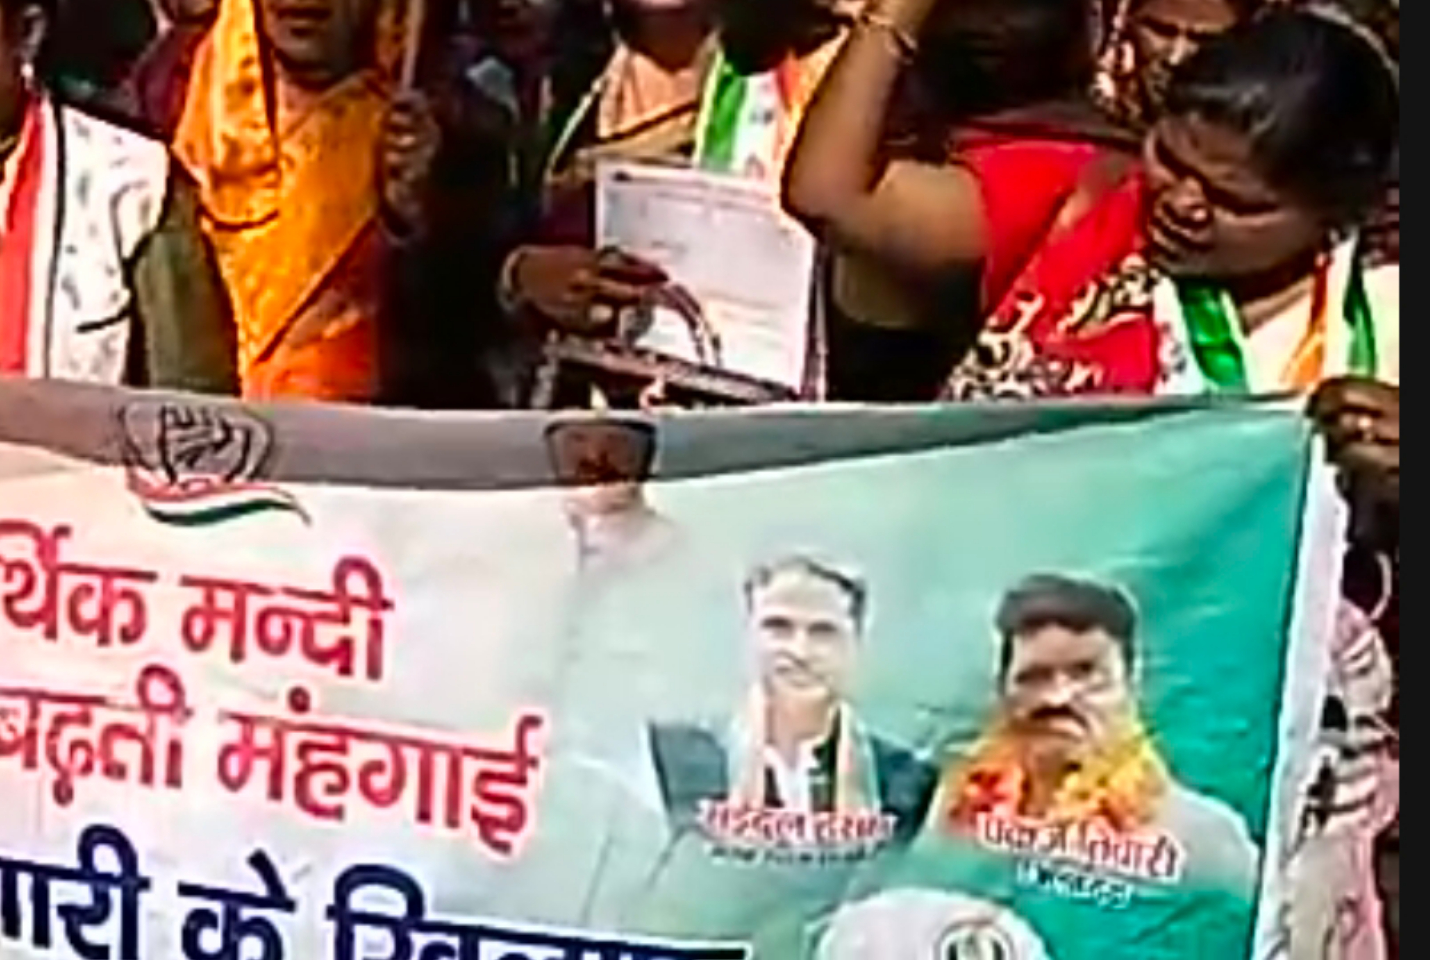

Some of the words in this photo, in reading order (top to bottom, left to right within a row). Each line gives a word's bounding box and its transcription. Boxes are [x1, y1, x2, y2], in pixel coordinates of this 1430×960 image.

[180, 555, 395, 681] मन्दी
[217, 686, 543, 855] महंगाई
[177, 848, 296, 960] के
